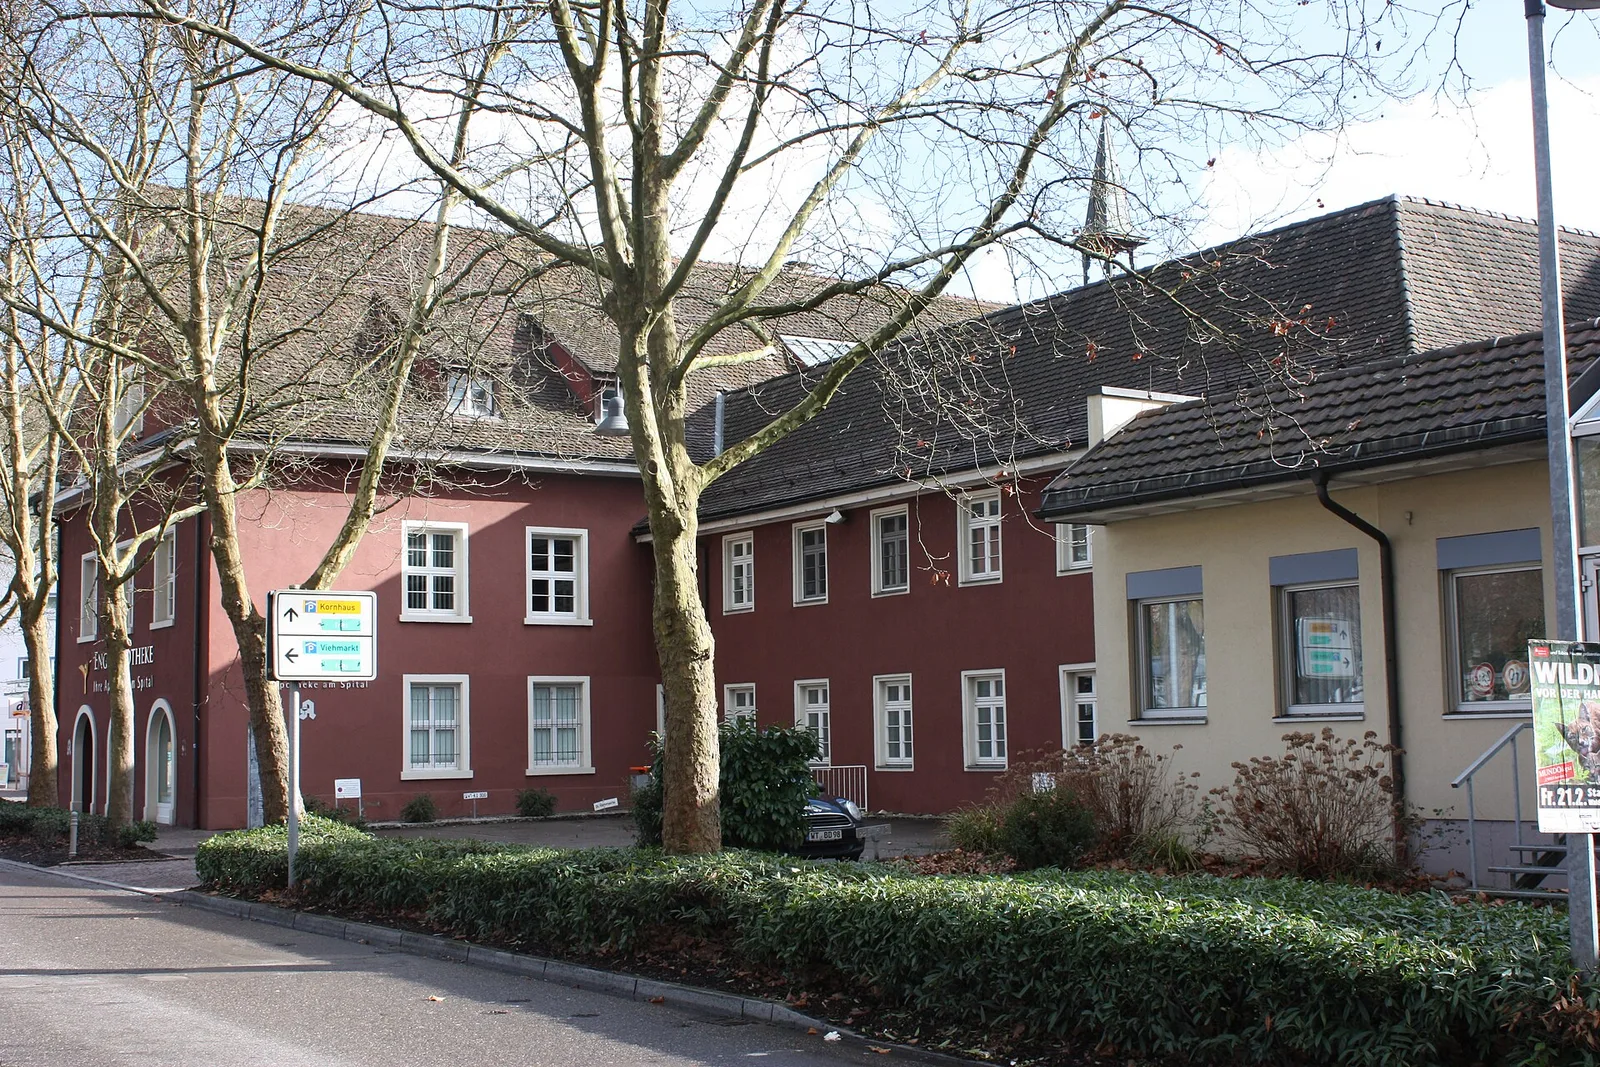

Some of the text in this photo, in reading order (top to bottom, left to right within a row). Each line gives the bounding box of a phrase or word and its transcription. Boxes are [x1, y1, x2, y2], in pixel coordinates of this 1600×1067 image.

[320, 603, 356, 611] Kornhaus
[320, 644, 359, 652] Viehmarkt
[93, 646, 154, 671] ENG OTHEKE
[137, 675, 154, 691] Spital
[322, 681, 336, 689] am
[340, 680, 369, 690] Spital
[1534, 687, 1557, 698] VOR
[1560, 688, 1580, 699] DER
[1540, 786, 1556, 806] Fr.
[1556, 786, 1588, 806] 21.2.
